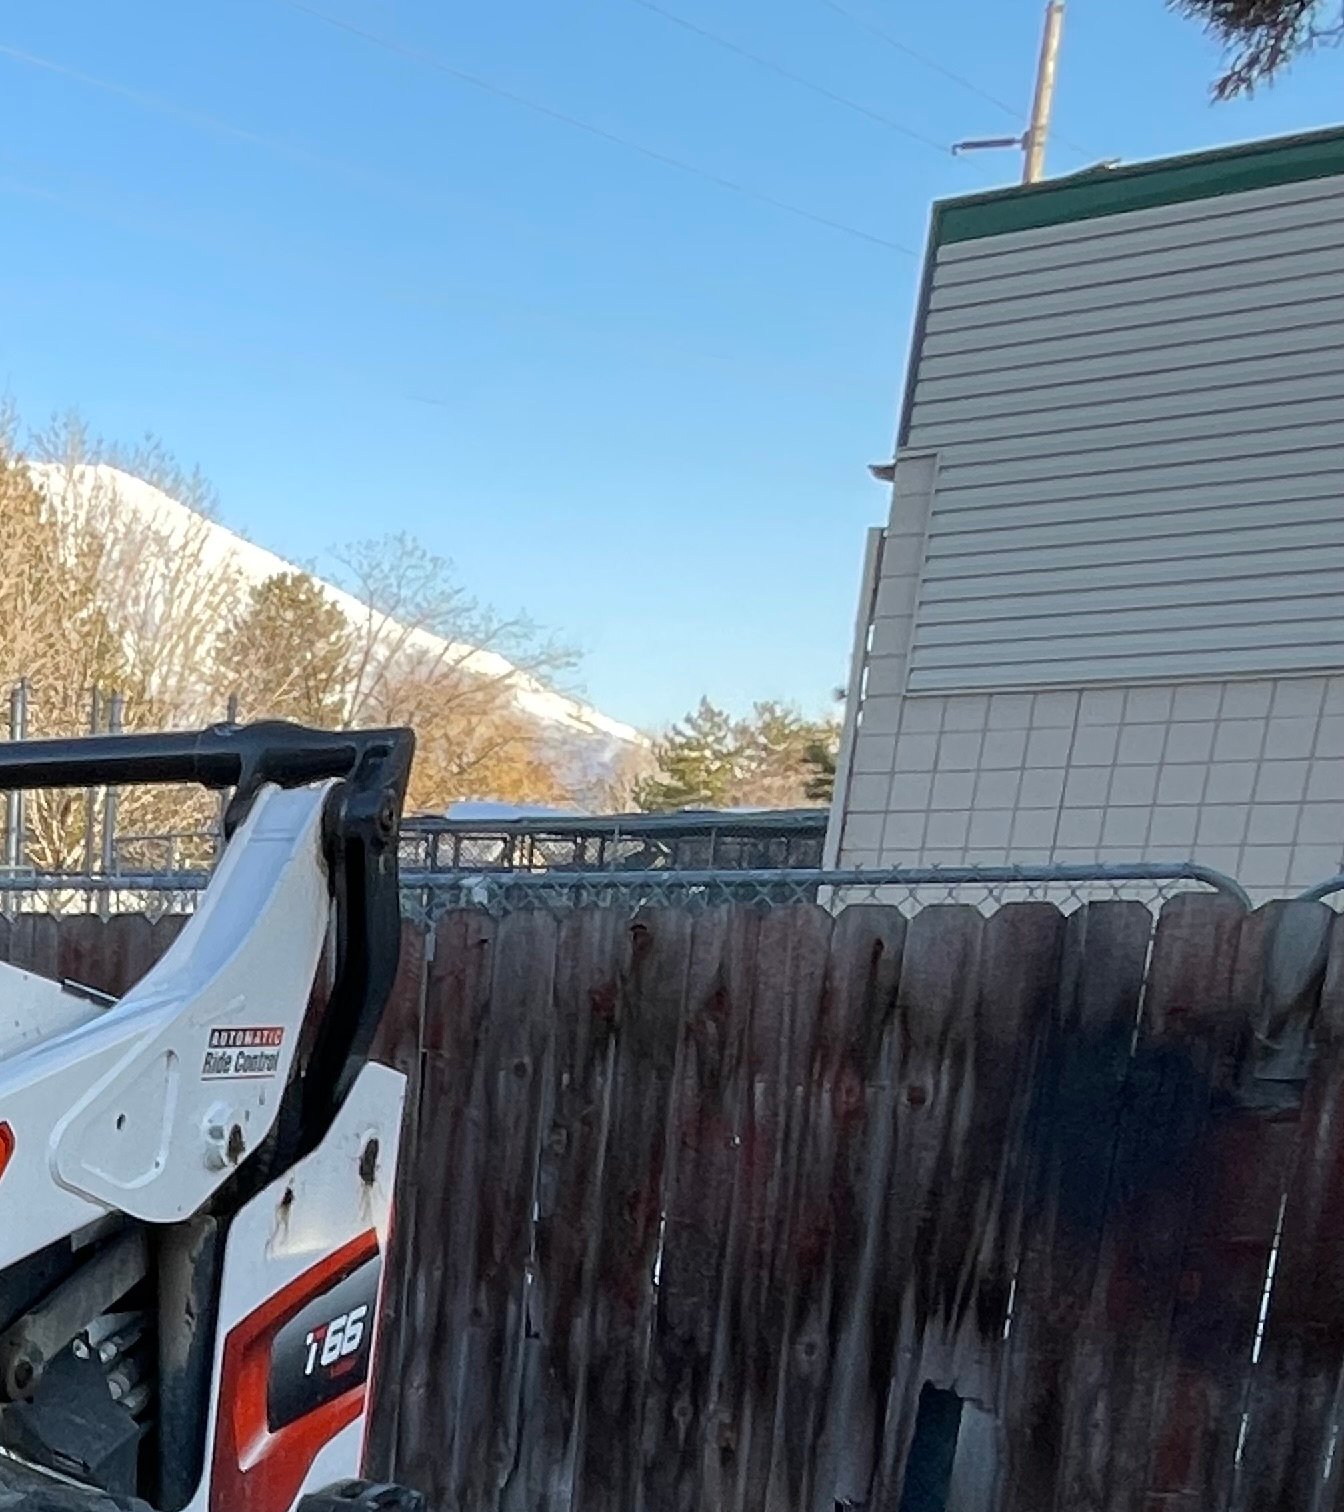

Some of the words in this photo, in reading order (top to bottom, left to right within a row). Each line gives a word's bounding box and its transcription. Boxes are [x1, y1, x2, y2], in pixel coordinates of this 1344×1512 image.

[212, 1029, 282, 1047] AUTOMATIC
[202, 1051, 233, 1074] Ride
[234, 1050, 280, 1073] Control
[304, 1304, 367, 1376] T66
